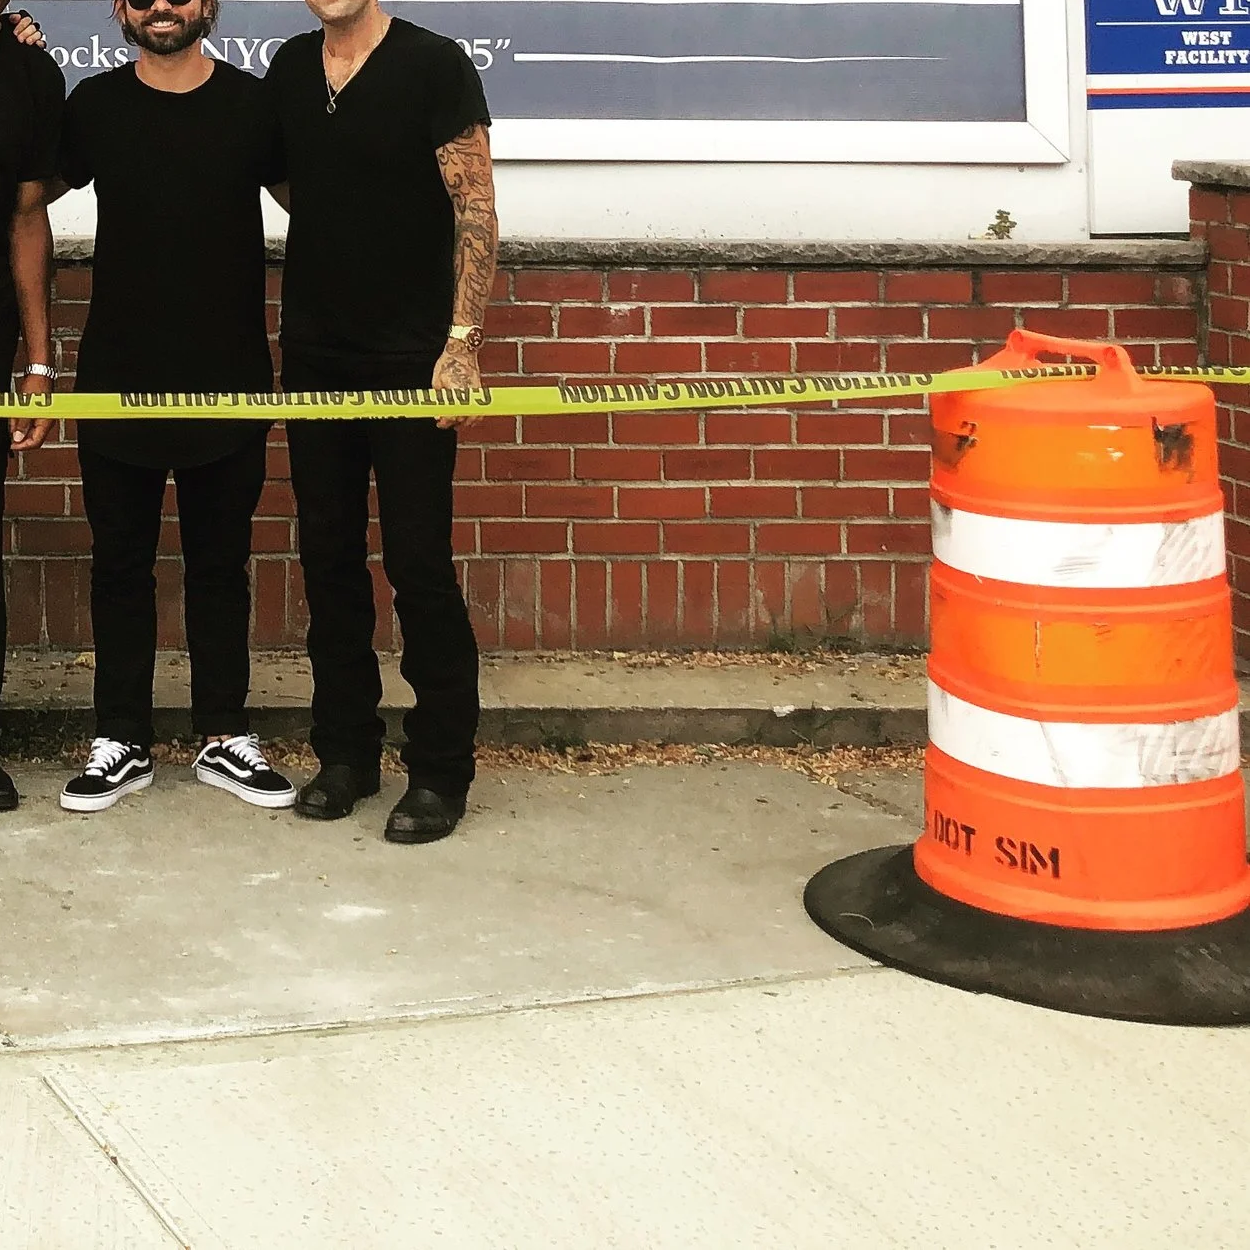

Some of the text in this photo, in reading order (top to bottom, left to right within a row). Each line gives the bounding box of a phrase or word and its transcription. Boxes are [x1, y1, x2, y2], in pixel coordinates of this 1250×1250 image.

[1181, 31, 1232, 46] WEST
[43, 35, 129, 68] ocks
[1164, 50, 1250, 65] FACILITY
[934, 810, 1060, 878] DOT SIM
